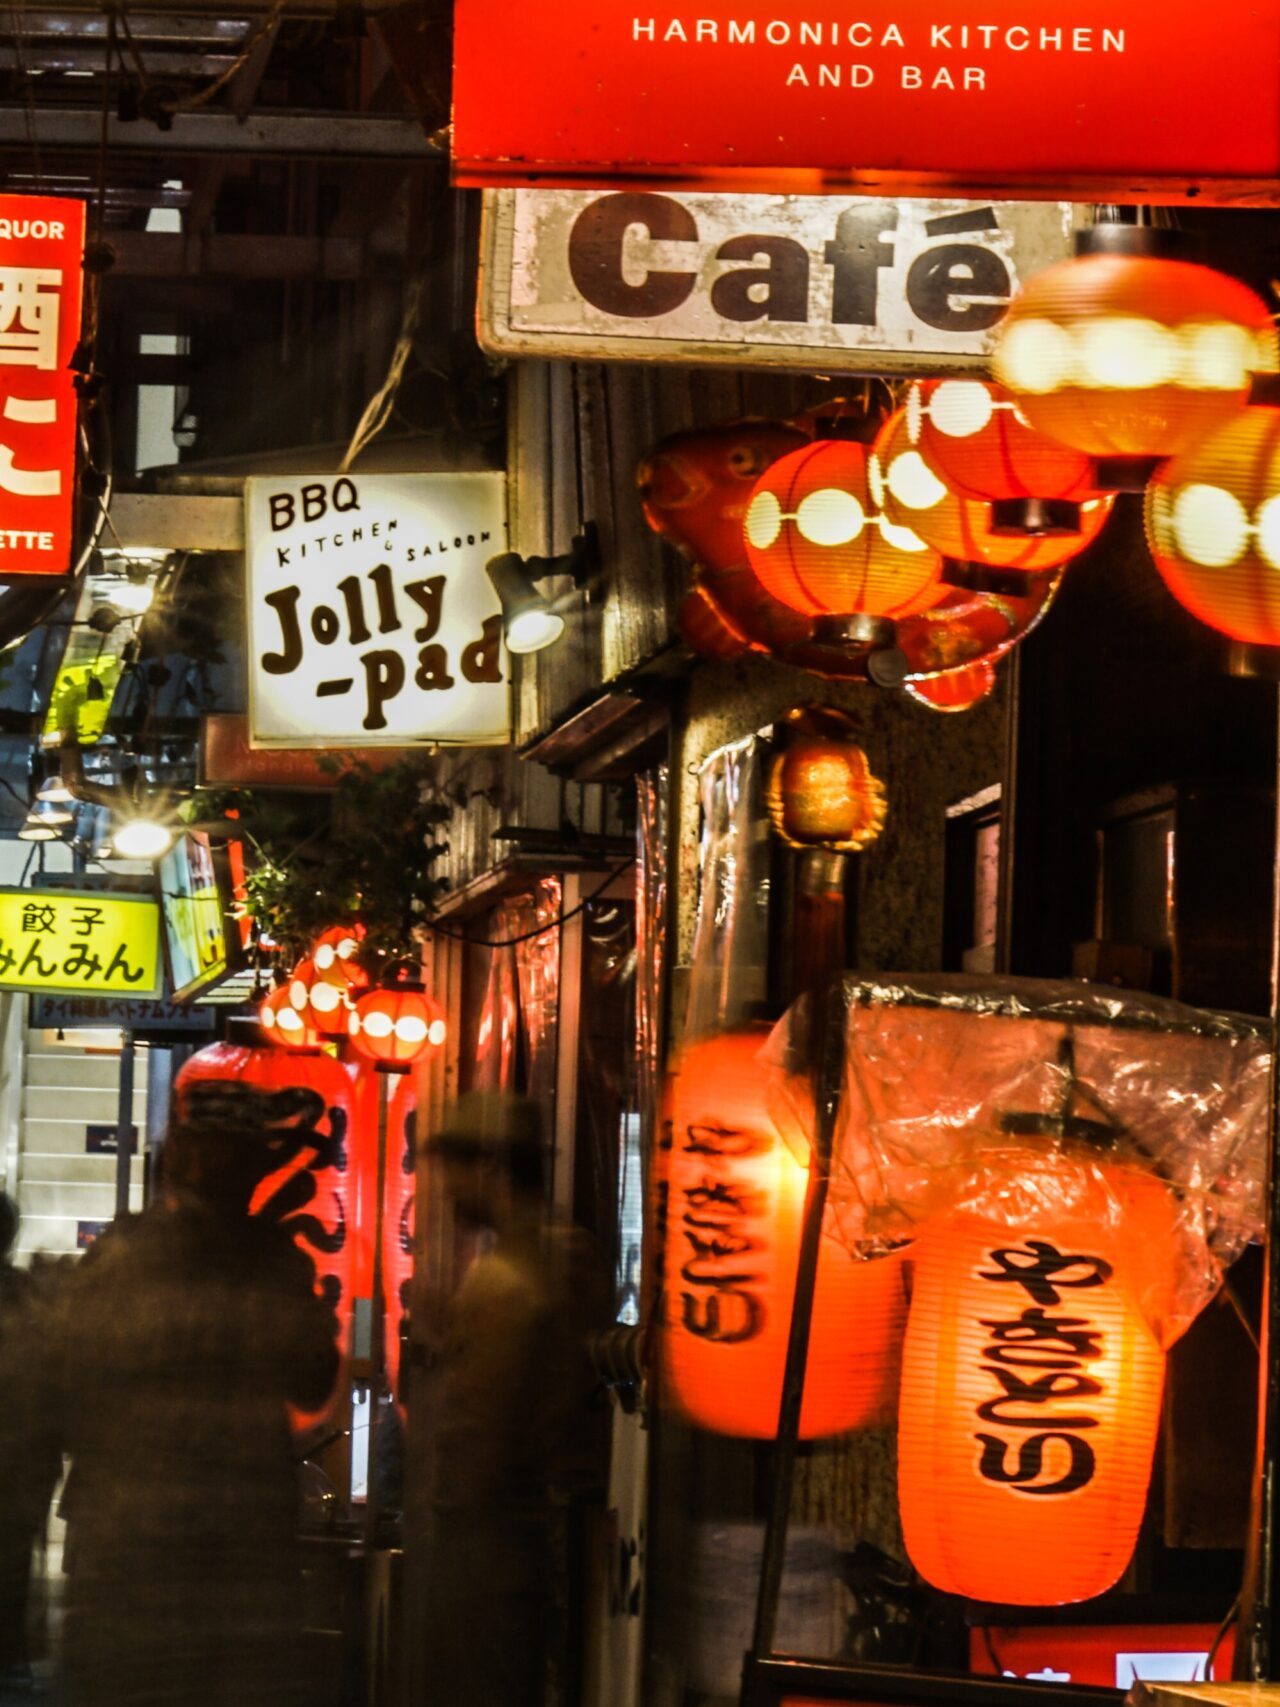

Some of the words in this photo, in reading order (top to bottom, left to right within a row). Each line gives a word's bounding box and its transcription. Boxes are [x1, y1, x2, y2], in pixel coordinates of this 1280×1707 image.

[631, 17, 905, 48] HARMONICA
[930, 23, 1128, 53] KITCHEN
[786, 64, 876, 89] AND
[900, 65, 988, 91] BAR
[567, 191, 1012, 333] Café
[268, 477, 360, 533] BBQ
[276, 519, 398, 568] KITCHEN
[406, 531, 491, 562] SALOON
[261, 563, 447, 675] Jolly
[21, 903, 105, 936] 餃子
